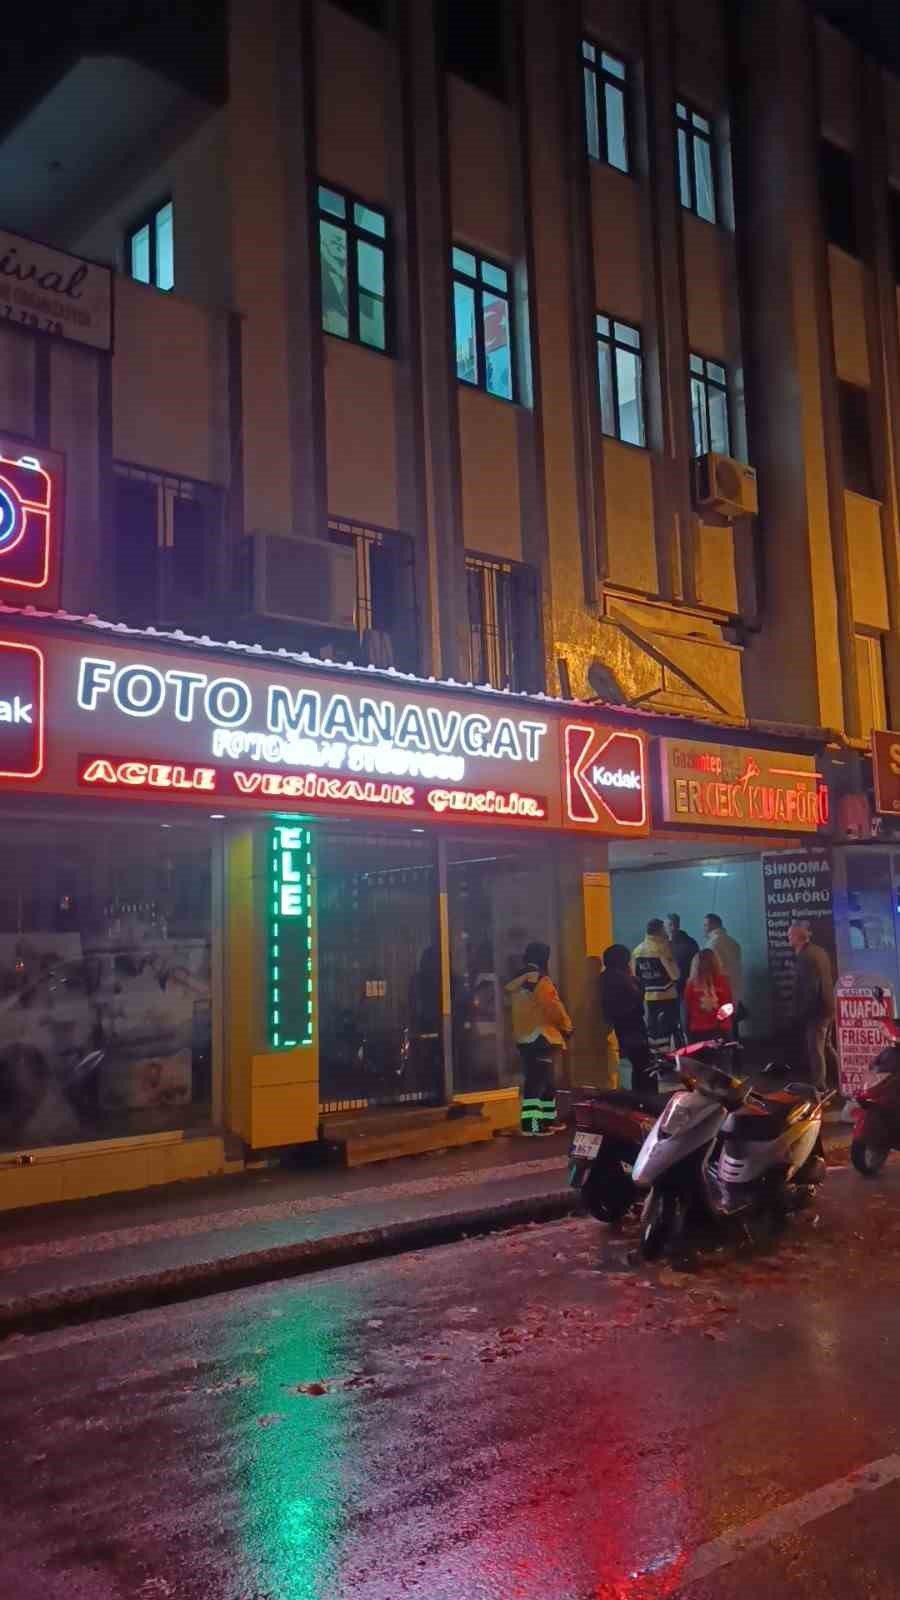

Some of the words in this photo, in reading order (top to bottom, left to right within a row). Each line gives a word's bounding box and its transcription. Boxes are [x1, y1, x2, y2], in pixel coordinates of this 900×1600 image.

[78, 657, 252, 727] FOTO
[267, 685, 547, 762] MANAVGAT
[83, 760, 216, 790] ACELE
[233, 772, 415, 806] VESİKALIK
[592, 765, 641, 790] Kodak
[674, 779, 743, 818] ERKEK
[748, 783, 829, 826] KUAFÖRÜ
[767, 888, 830, 905] KUAFÖRÜ
[774, 876, 816, 890] BAYAN
